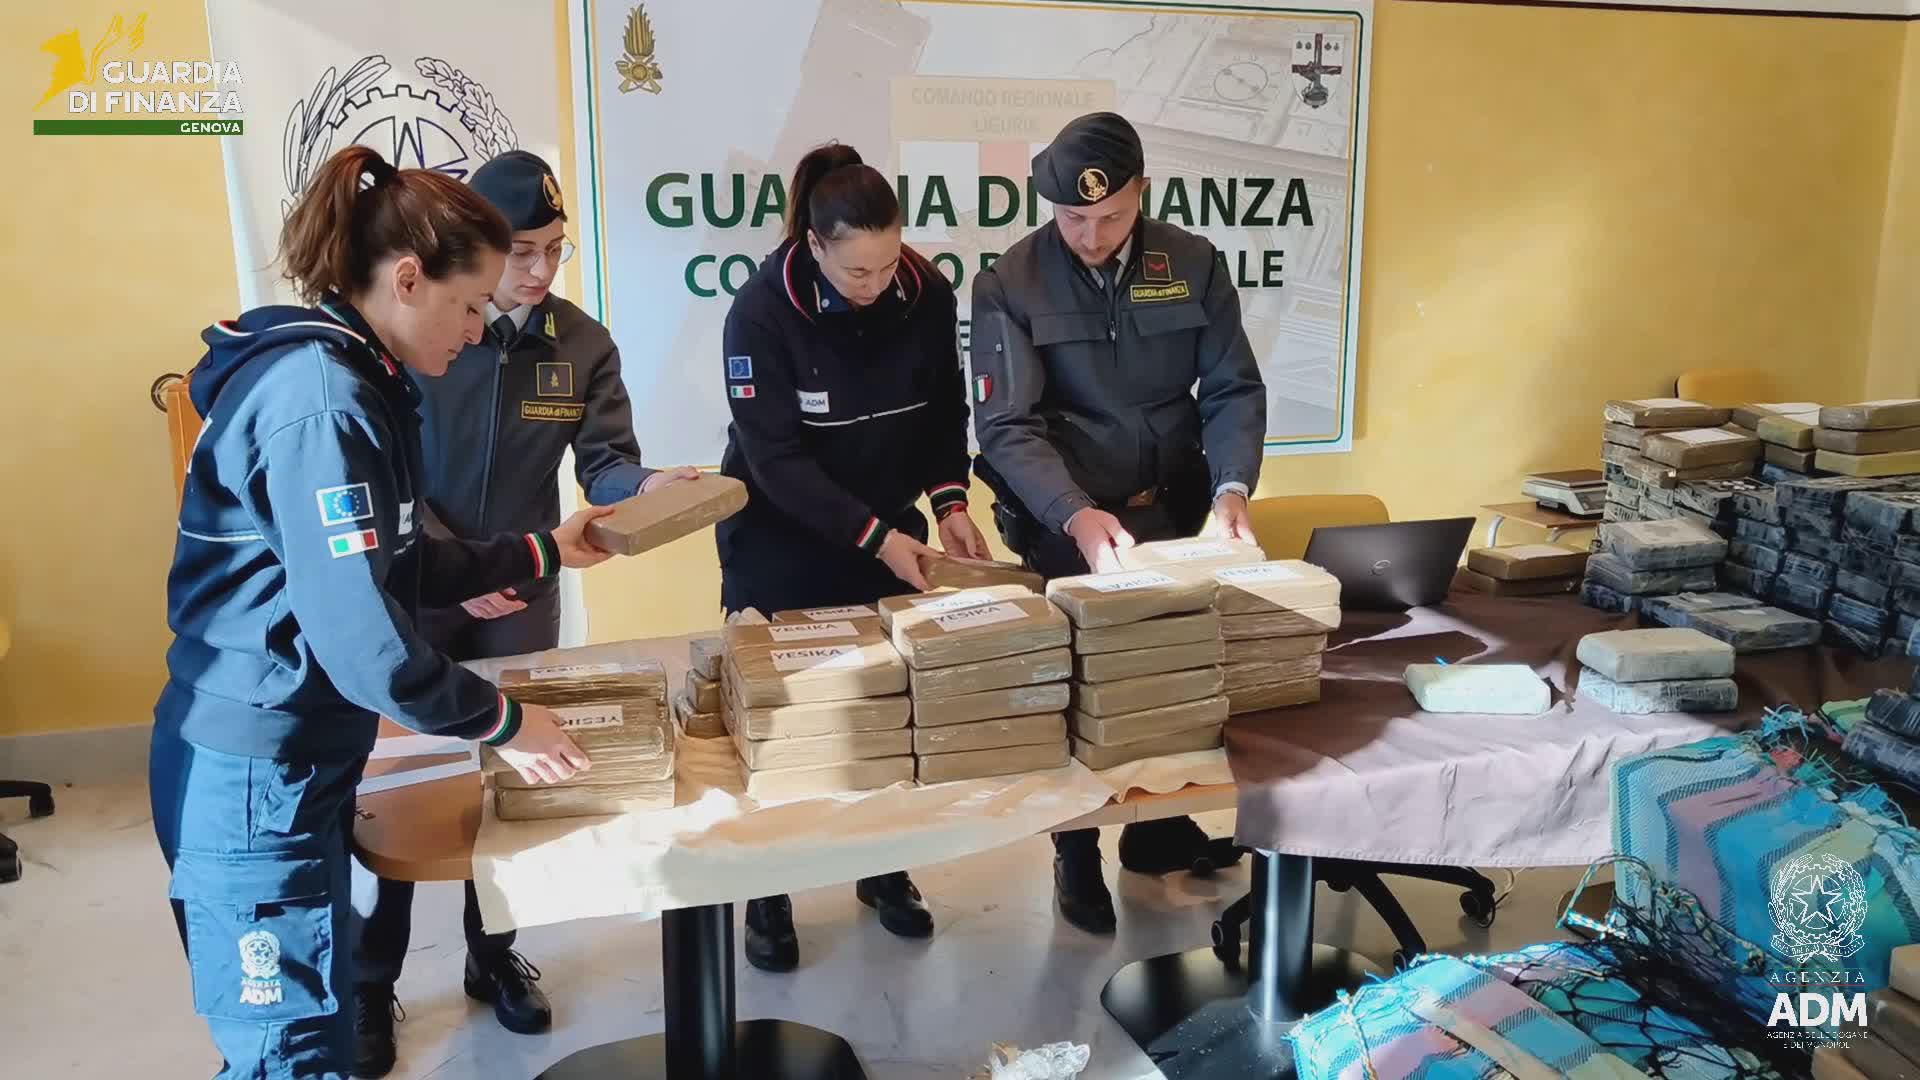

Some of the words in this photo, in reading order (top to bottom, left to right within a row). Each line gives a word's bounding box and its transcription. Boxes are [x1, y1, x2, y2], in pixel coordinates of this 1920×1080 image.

[645, 172, 958, 229] GUAIA
[977, 175, 1037, 227] DI
[1143, 177, 1314, 227] ANZA
[935, 606, 1001, 622] YESIKA
[771, 623, 838, 633] YESIKA
[773, 648, 844, 660] YESIKA
[560, 715, 621, 727] YESIK
[239, 986, 283, 1004] ADM
